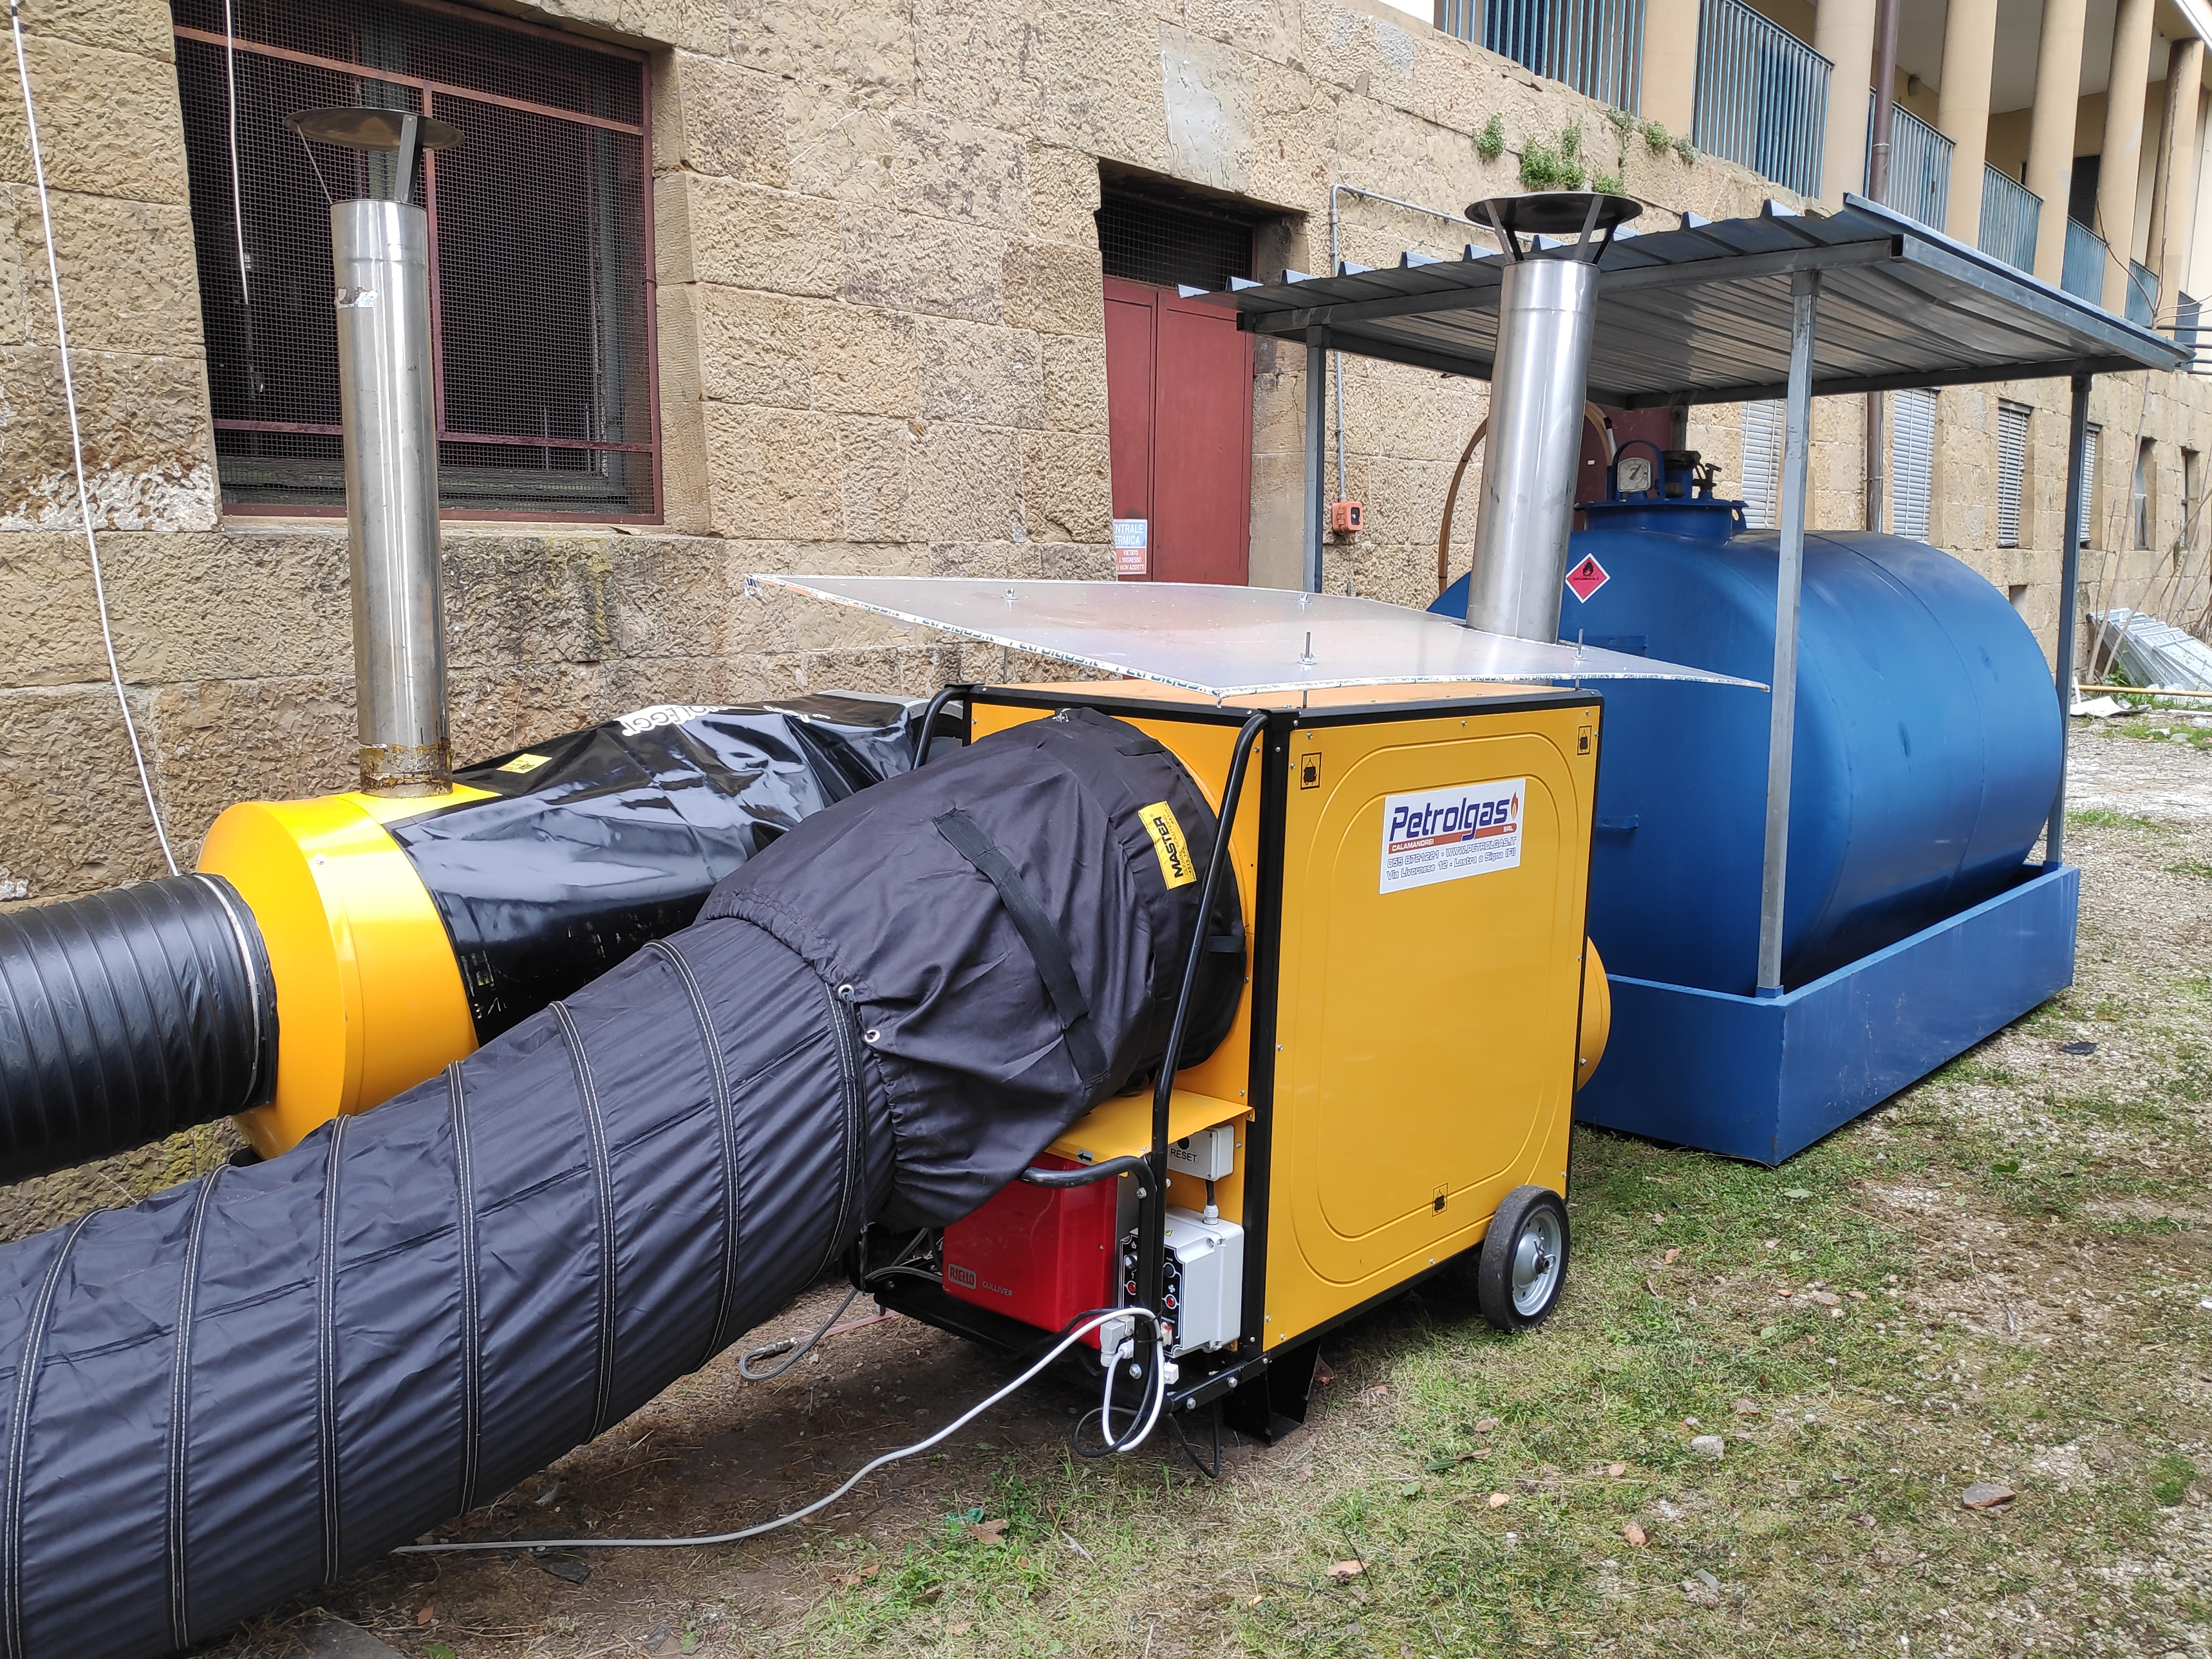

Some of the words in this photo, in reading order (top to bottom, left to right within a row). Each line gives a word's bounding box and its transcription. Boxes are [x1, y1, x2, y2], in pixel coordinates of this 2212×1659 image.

[1114, 536, 1141, 545] ERMICA
[1389, 797, 1510, 841] Petrolgas
[1153, 816, 1184, 879] MASTER
[1391, 838, 1434, 852] CALAMANDREI
[1445, 836, 1517, 858] WWW.PETROLGAS.IT
[1387, 868, 1400, 881] Via
[1400, 863, 1436, 877] Livornese
[1438, 859, 1448, 870] 12
[1454, 854, 1477, 867] Lastra
[1478, 854, 1484, 863] a
[1485, 850, 1504, 863] Signa
[1170, 1148, 1198, 1163] RESET
[950, 1267, 975, 1286] RIELLO
[982, 1281, 1013, 1297] GULLIVER
